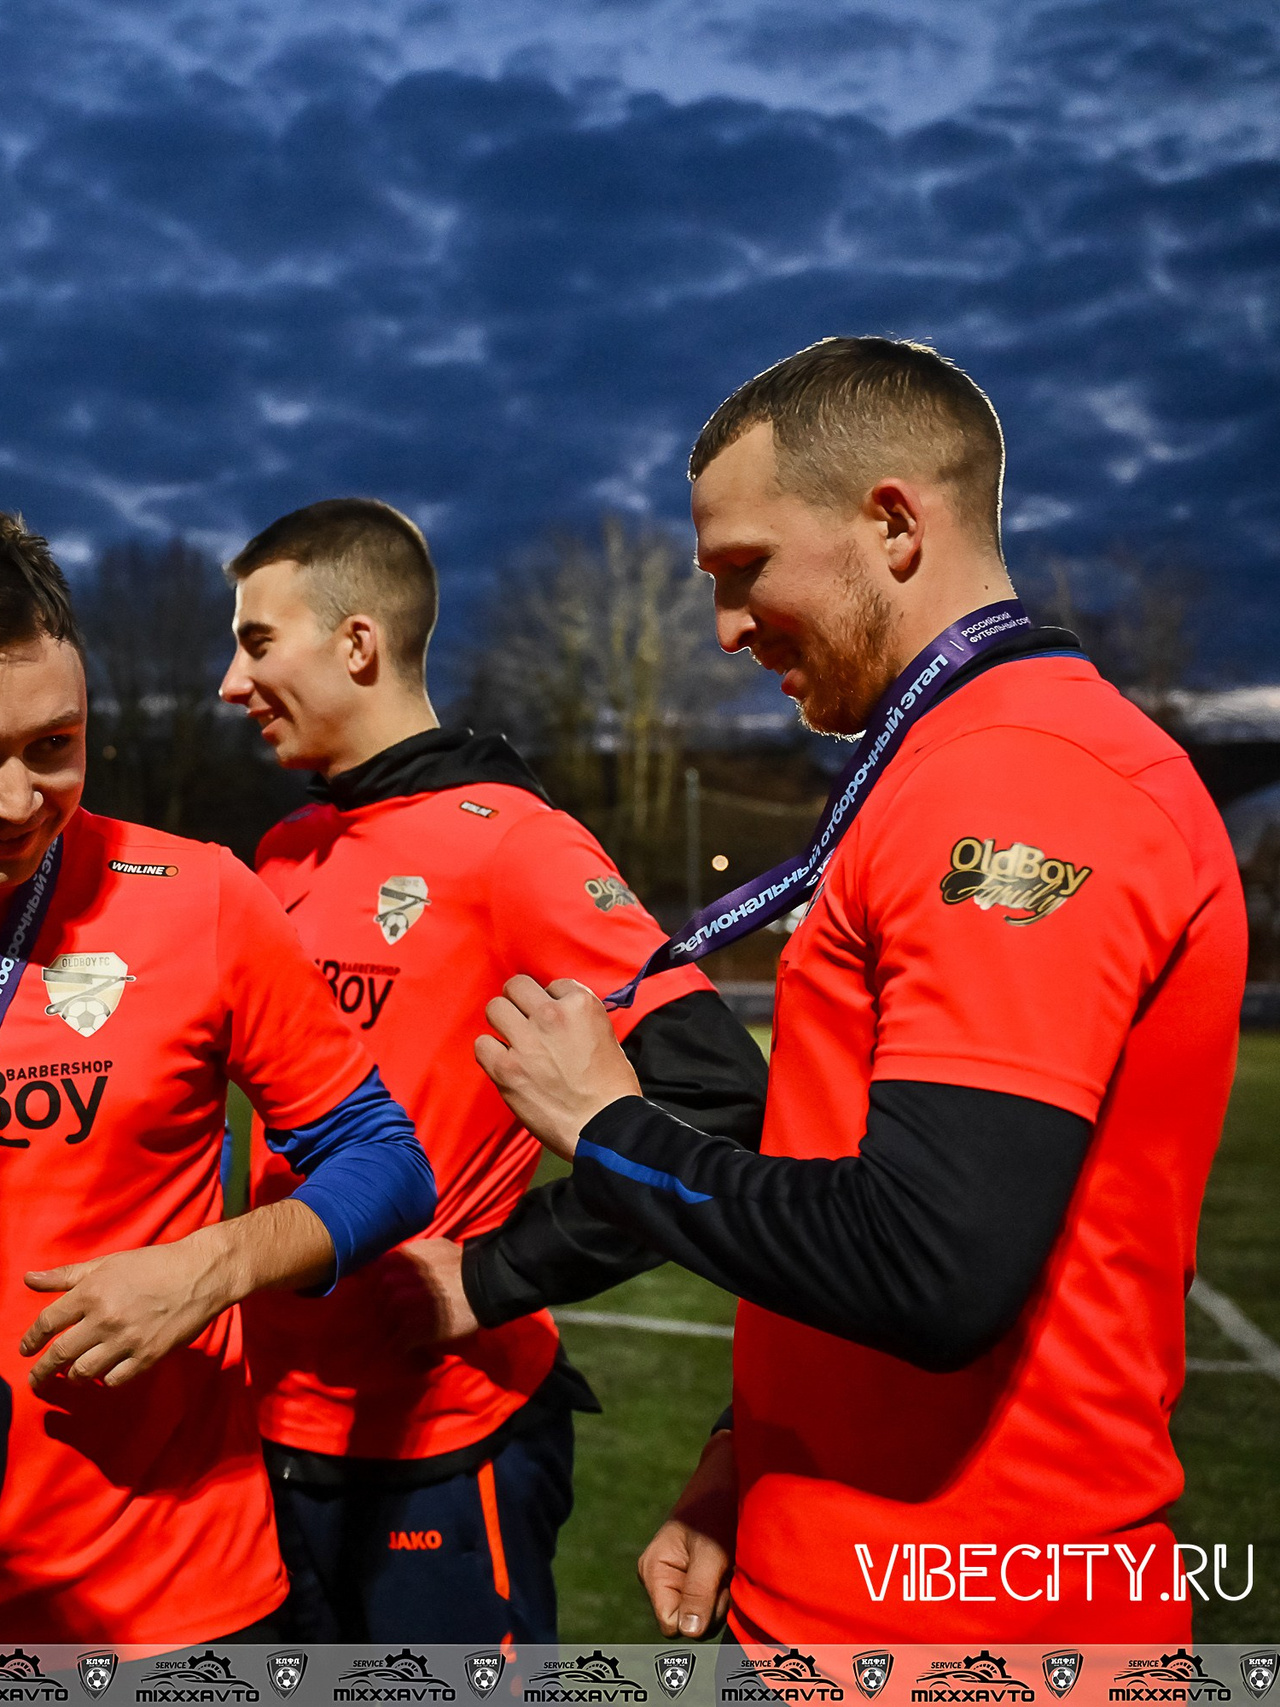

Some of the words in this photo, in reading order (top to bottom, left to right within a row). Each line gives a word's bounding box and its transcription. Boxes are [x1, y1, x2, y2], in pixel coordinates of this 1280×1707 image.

[961, 611, 1012, 637] РОССИЙСКИЙ
[969, 619, 1018, 643] ФУТБОЛЬНЫЙ
[820, 706, 905, 848] отборочный
[900, 653, 949, 710] этап
[111, 861, 166, 876] WINLINE
[951, 837, 1091, 896] OldBoy
[61, 957, 97, 968] OLDBOY
[99, 956, 110, 966] FC
[6, 1060, 113, 1081] BARBERSHOP
